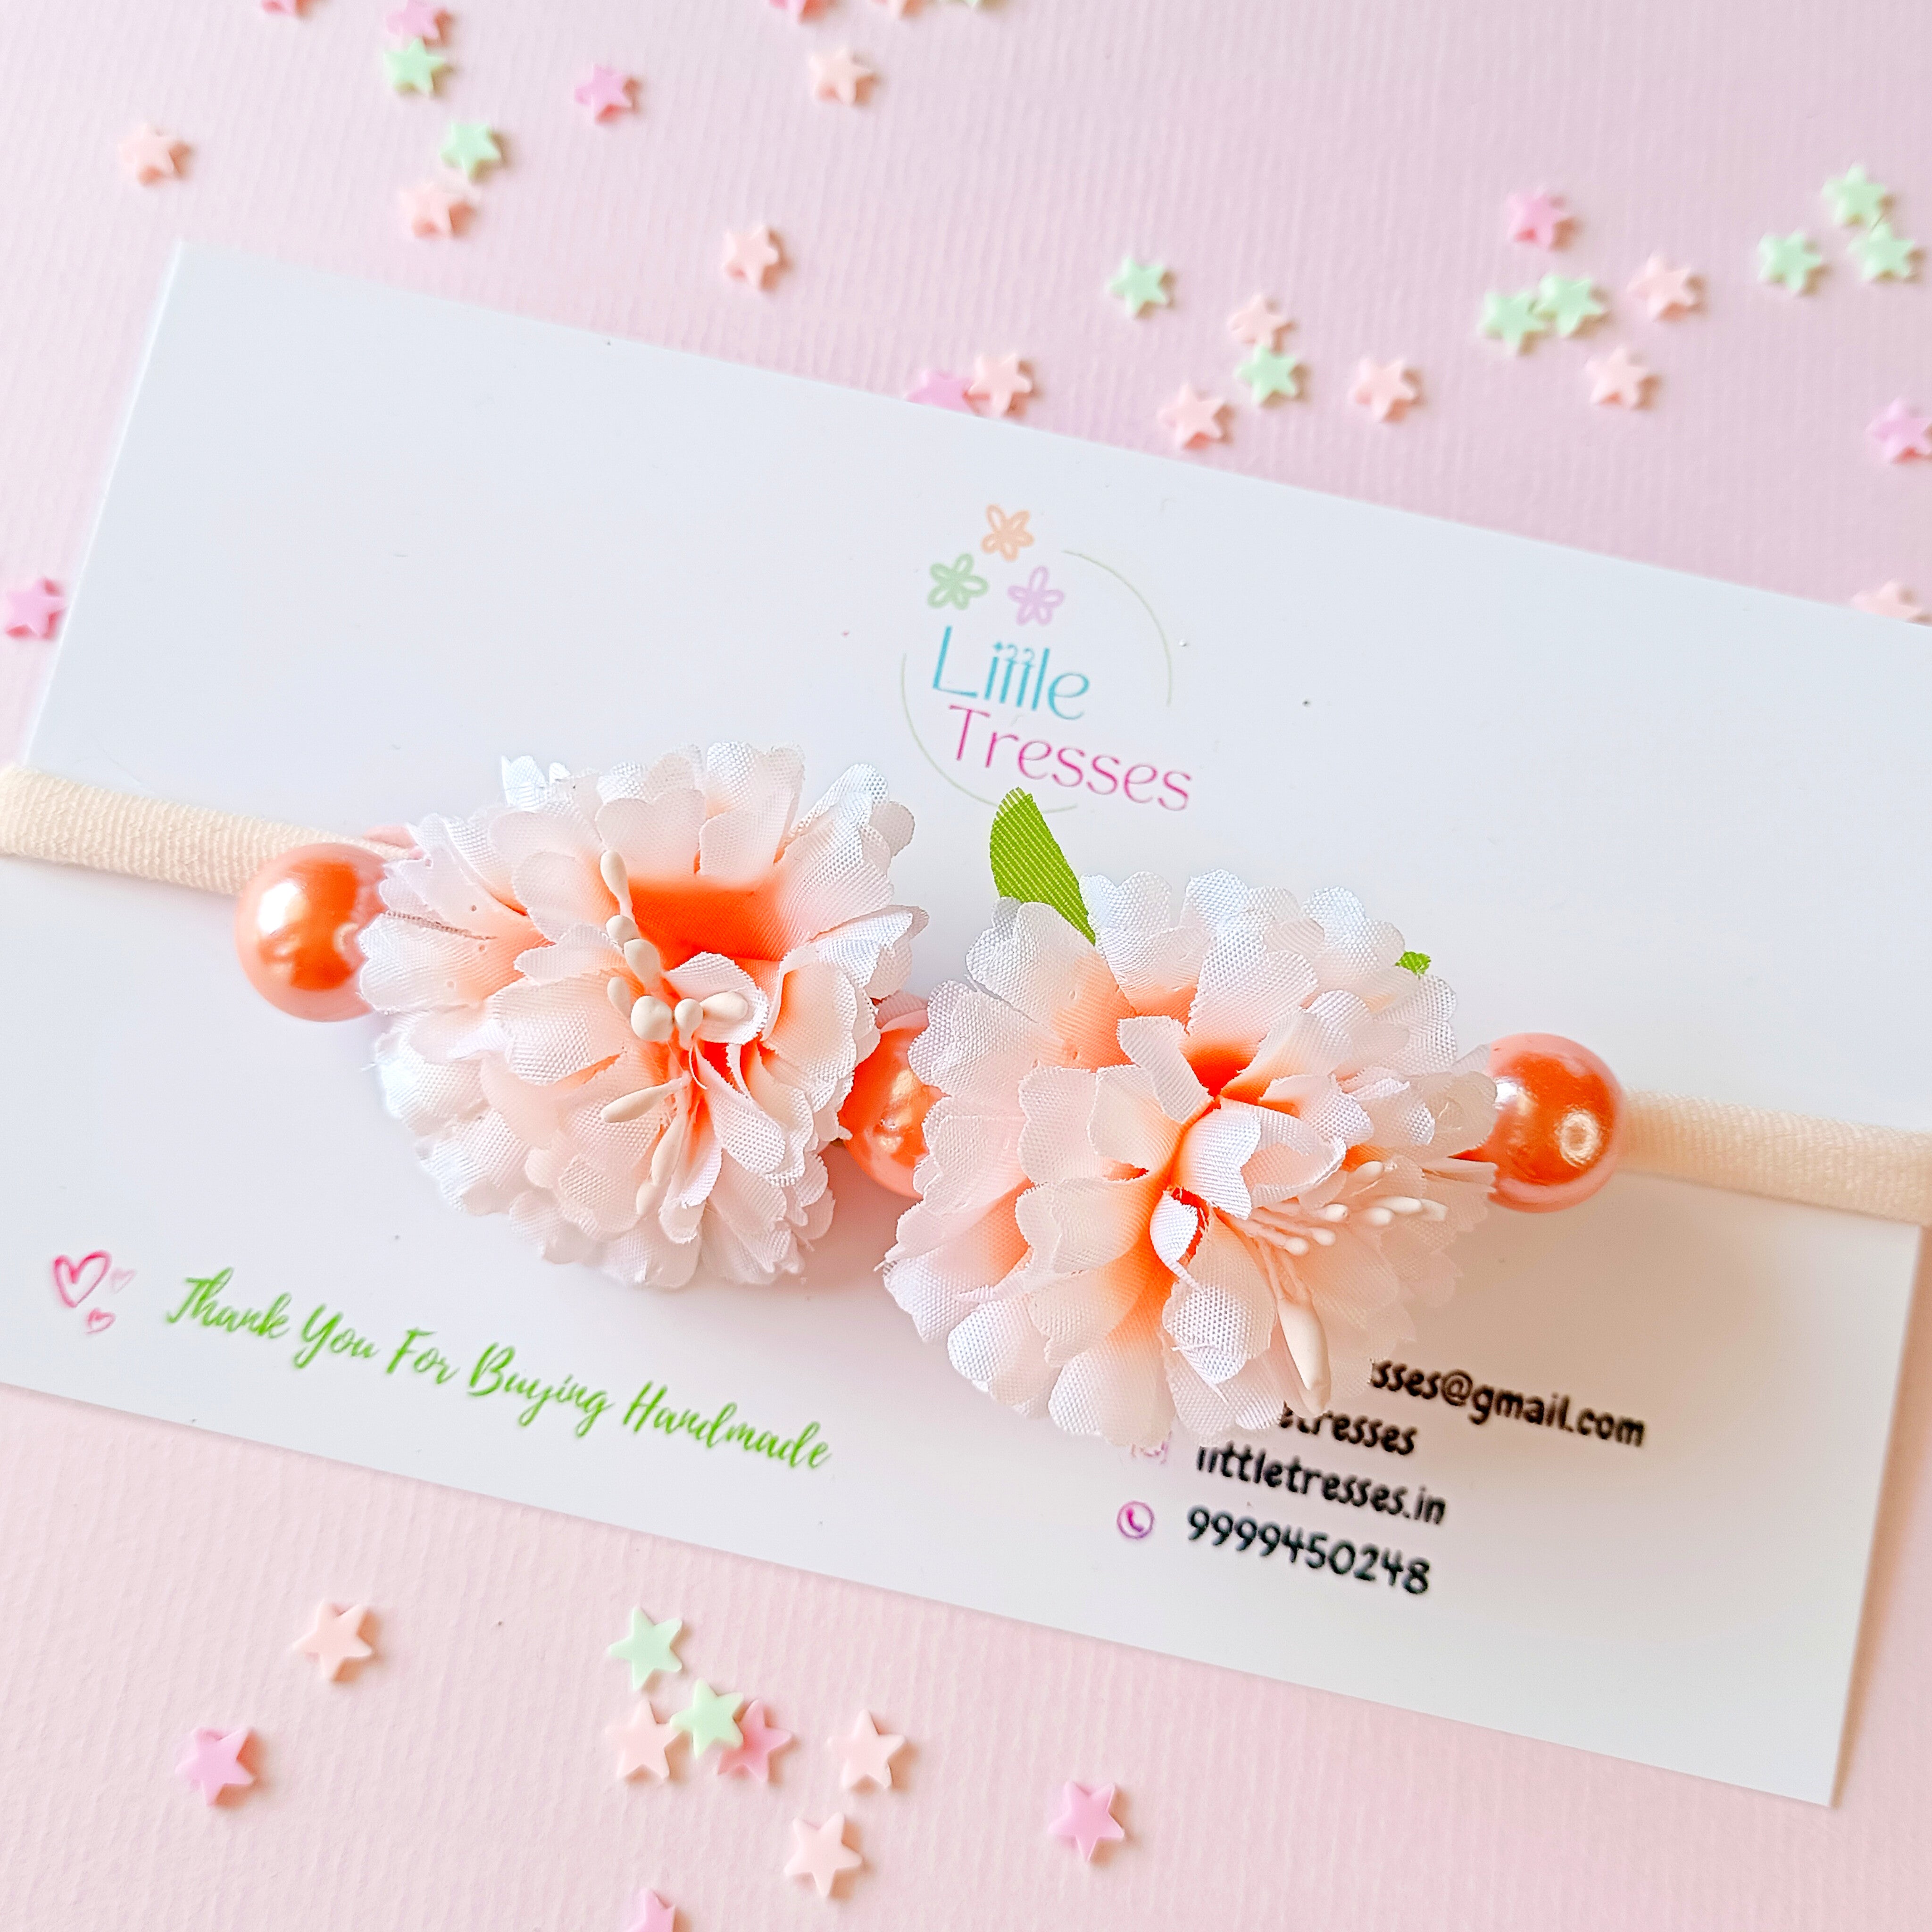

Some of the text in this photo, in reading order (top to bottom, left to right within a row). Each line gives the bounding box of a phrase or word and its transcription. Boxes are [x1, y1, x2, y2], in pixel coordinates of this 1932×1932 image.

[932, 625, 1090, 720] Little
[949, 704, 1191, 811] Tresses
[166, 1267, 831, 1469] Thank You For Buying Handmade
[1370, 1359, 1646, 1447] sses@gmail.com
[1187, 1506, 1431, 1595] 9999450248
